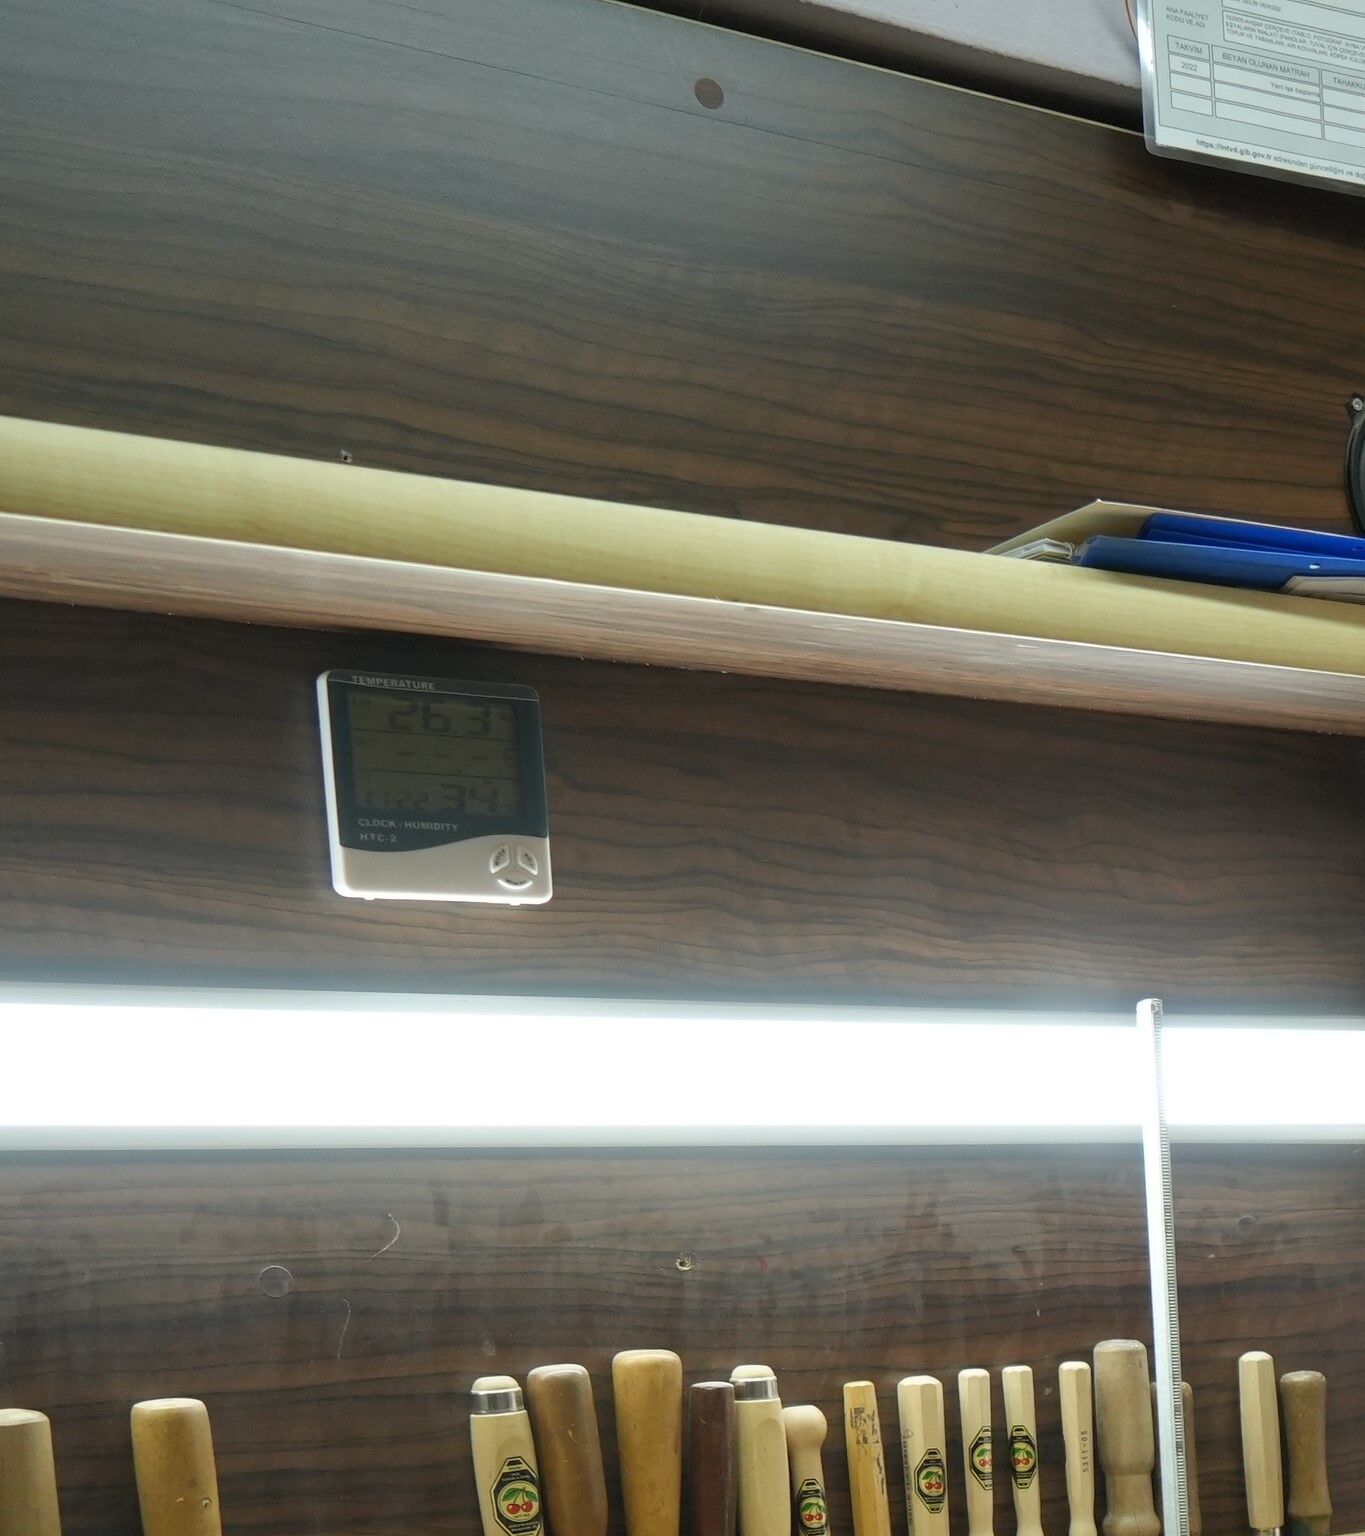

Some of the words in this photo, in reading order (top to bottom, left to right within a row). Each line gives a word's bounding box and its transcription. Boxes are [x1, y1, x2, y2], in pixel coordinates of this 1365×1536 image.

[1182, 62, 1198, 72] 2022
[1222, 52, 1247, 64] BEYAN
[1248, 58, 1279, 71] OLUNAN
[352, 675, 436, 691] TEMPERATURE
[358, 817, 396, 829] CLOCK
[404, 820, 459, 832] HUMIDITY
[359, 833, 398, 843] HTC-2
